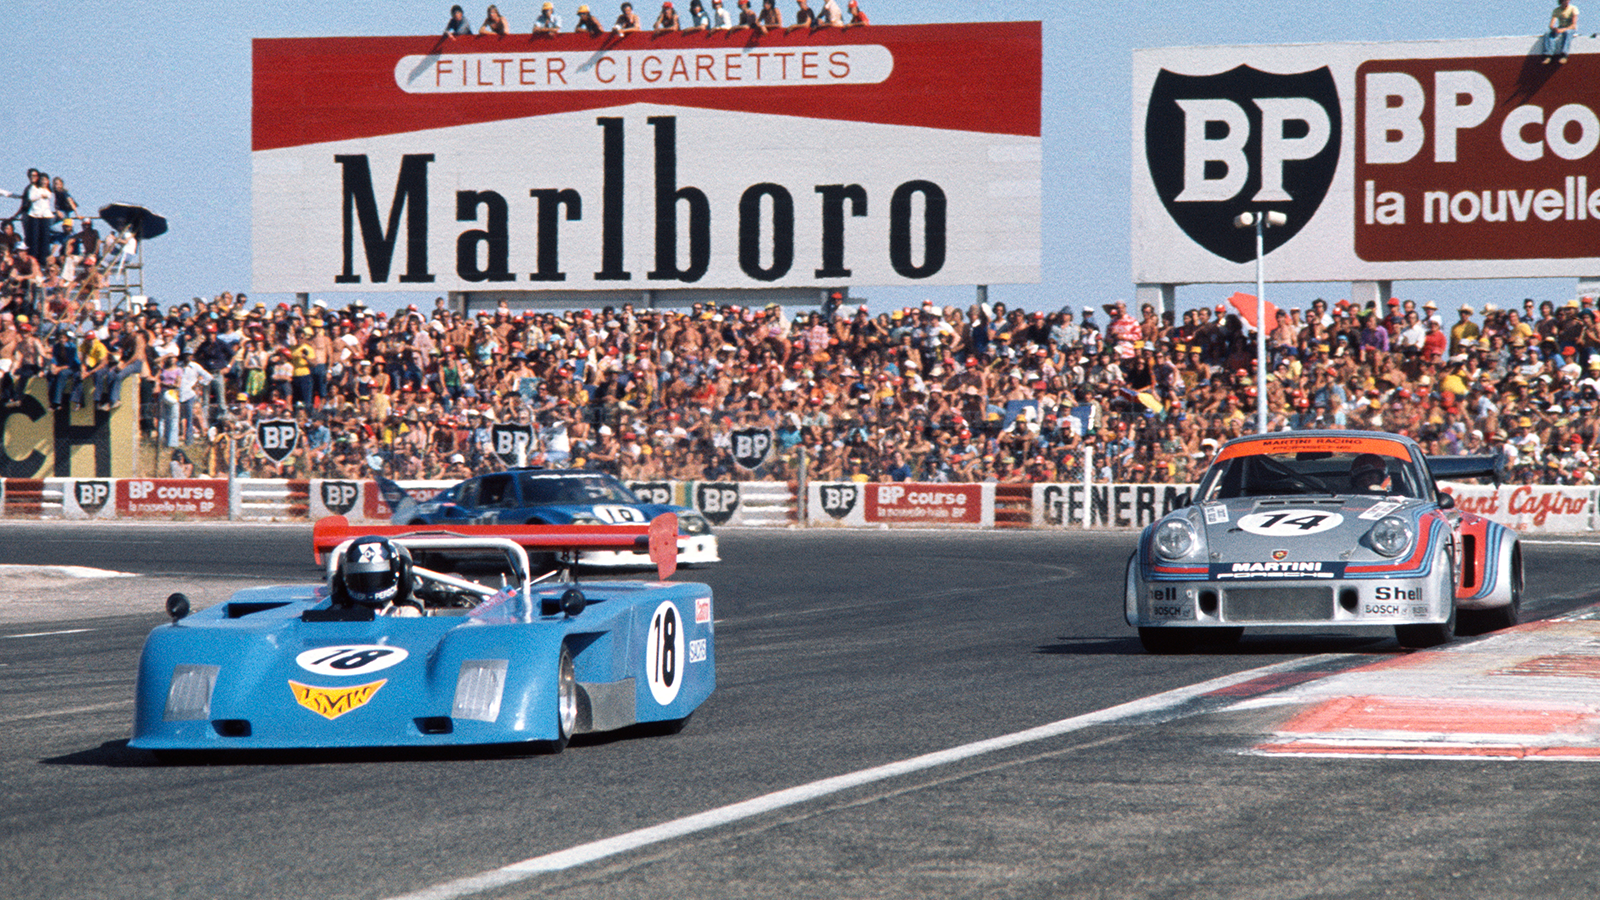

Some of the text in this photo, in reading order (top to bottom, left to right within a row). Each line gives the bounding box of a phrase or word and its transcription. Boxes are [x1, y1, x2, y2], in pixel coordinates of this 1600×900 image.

[436, 52, 851, 87] FILTER CIGARETTES
[1365, 70, 1600, 164] BP co
[1174, 97, 1331, 202] BP
[334, 116, 947, 284] Marlboro
[1365, 180, 1405, 225] la
[263, 425, 295, 449] BP
[497, 430, 529, 455] BP
[737, 434, 768, 458] BP
[80, 484, 108, 504] BP
[129, 481, 215, 499] BP course
[327, 484, 356, 505] BP
[704, 488, 737, 512] BP
[825, 488, 854, 509] BP
[878, 486, 967, 505] BP course
[200, 501, 215, 512] BP
[1259, 513, 1329, 530] 14
[1232, 562, 1322, 572] MARTINI
[1375, 586, 1422, 600] Shell
[1365, 604, 1399, 614] BOSCH
[654, 607, 676, 687] 18
[310, 648, 394, 670] 18
[301, 686, 371, 714] KMW
